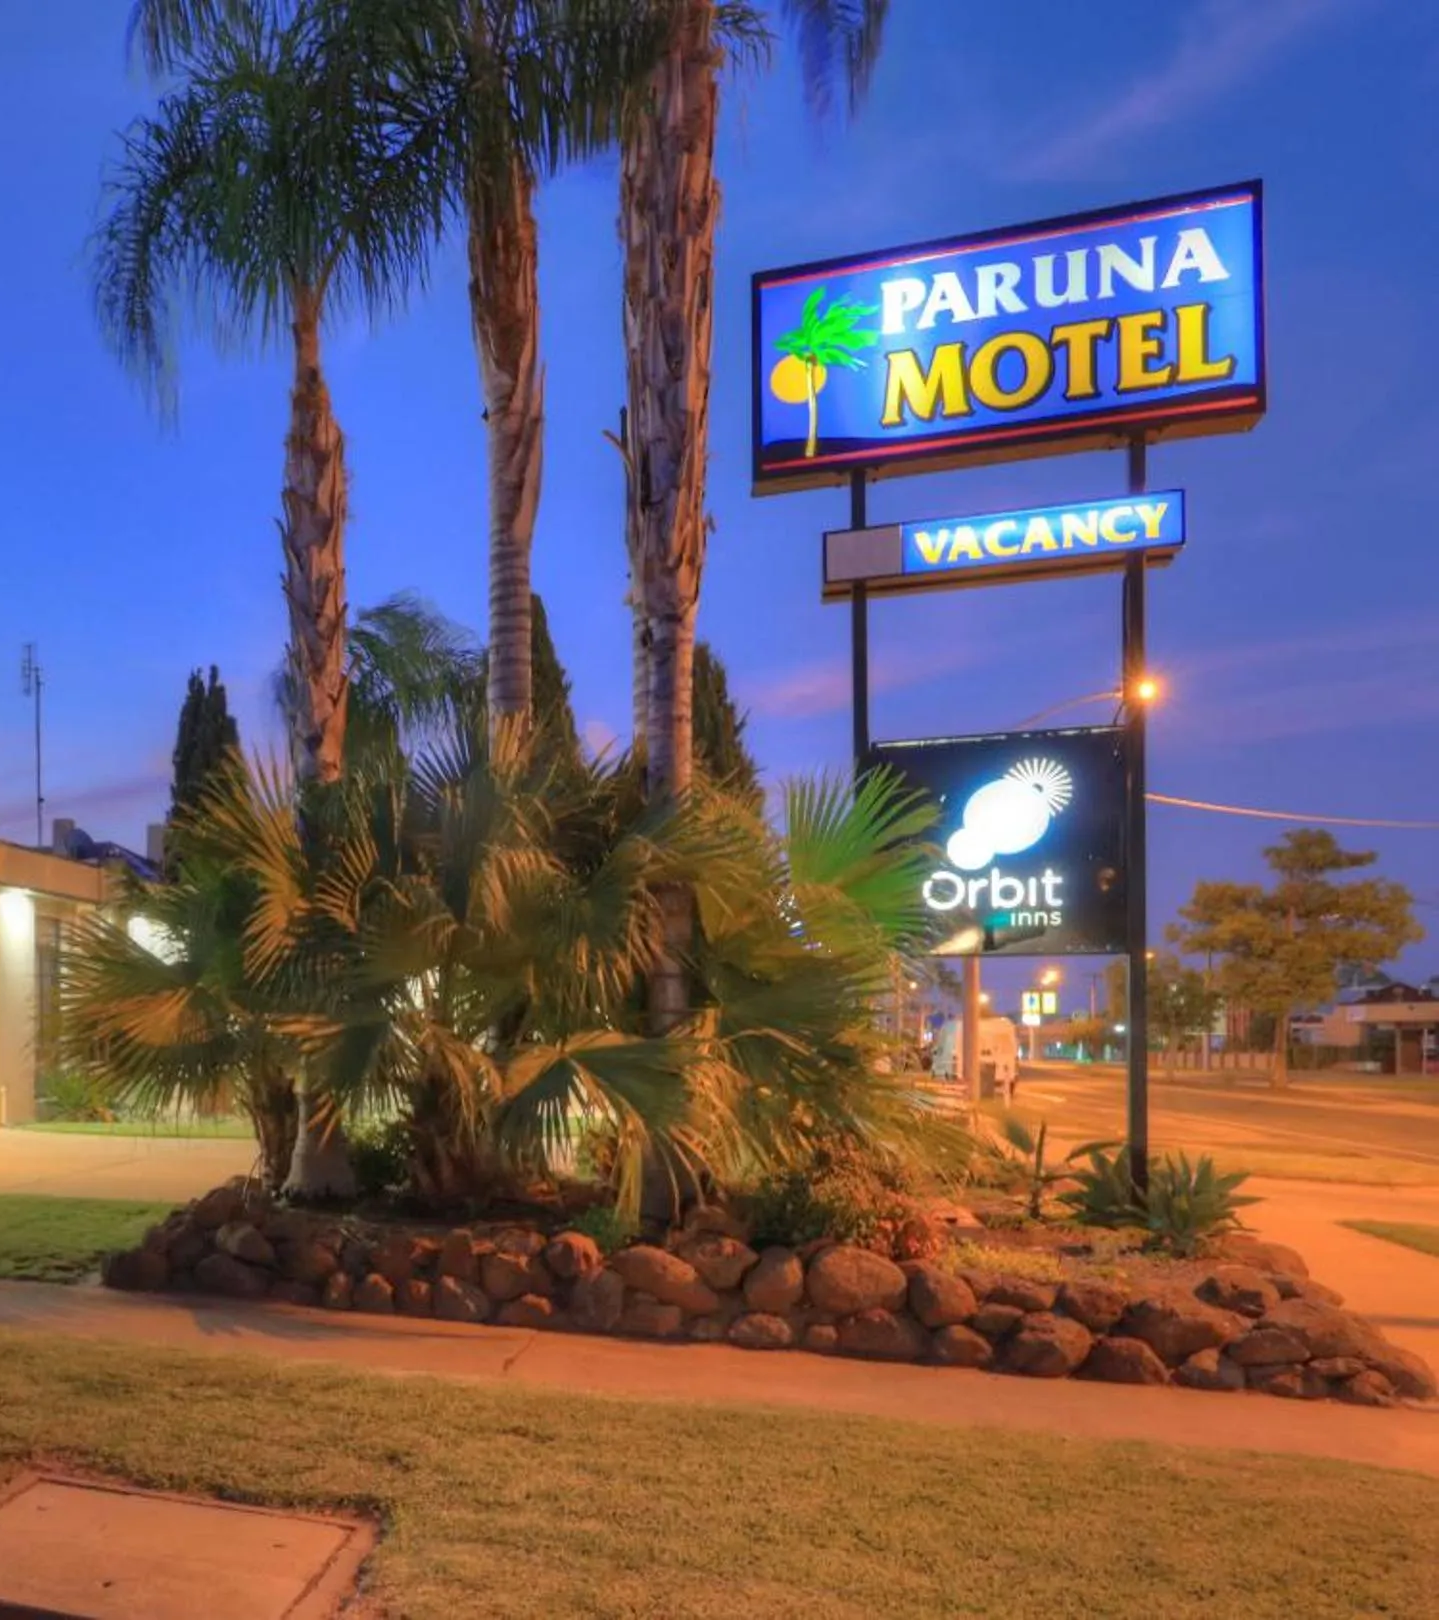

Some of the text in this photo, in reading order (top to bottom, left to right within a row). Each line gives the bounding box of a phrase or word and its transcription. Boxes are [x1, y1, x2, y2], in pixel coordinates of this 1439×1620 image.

[880, 227, 1231, 335] PARUNA
[879, 304, 1237, 428] MOTEL
[913, 503, 1169, 565] VACANCY
[922, 867, 1064, 911] Orbit
[1010, 909, 1062, 927] inns
